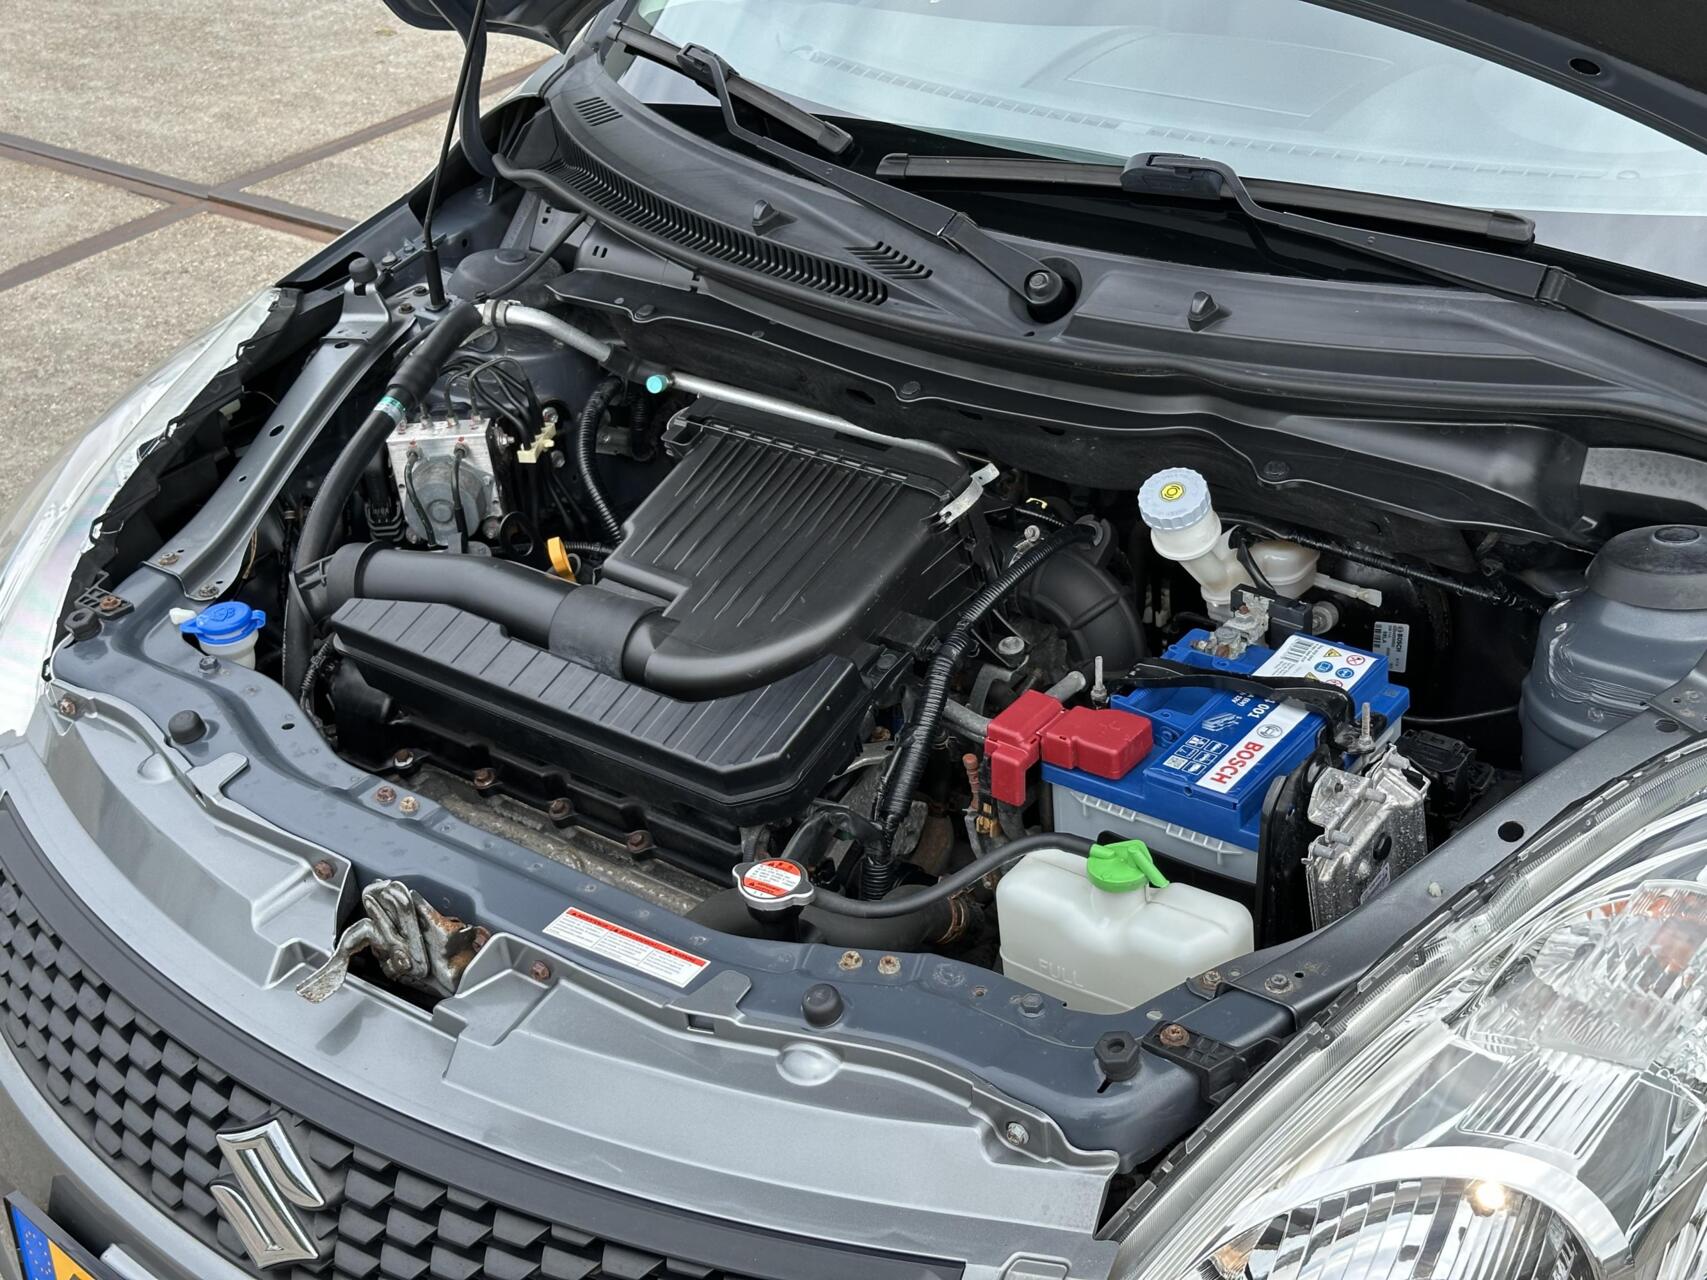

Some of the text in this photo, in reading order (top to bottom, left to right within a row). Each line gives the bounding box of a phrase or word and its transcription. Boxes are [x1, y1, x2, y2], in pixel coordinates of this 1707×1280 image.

[1247, 703, 1270, 719] 001
[1209, 740, 1265, 785] BOSCH
[1038, 957, 1084, 988] FULL
